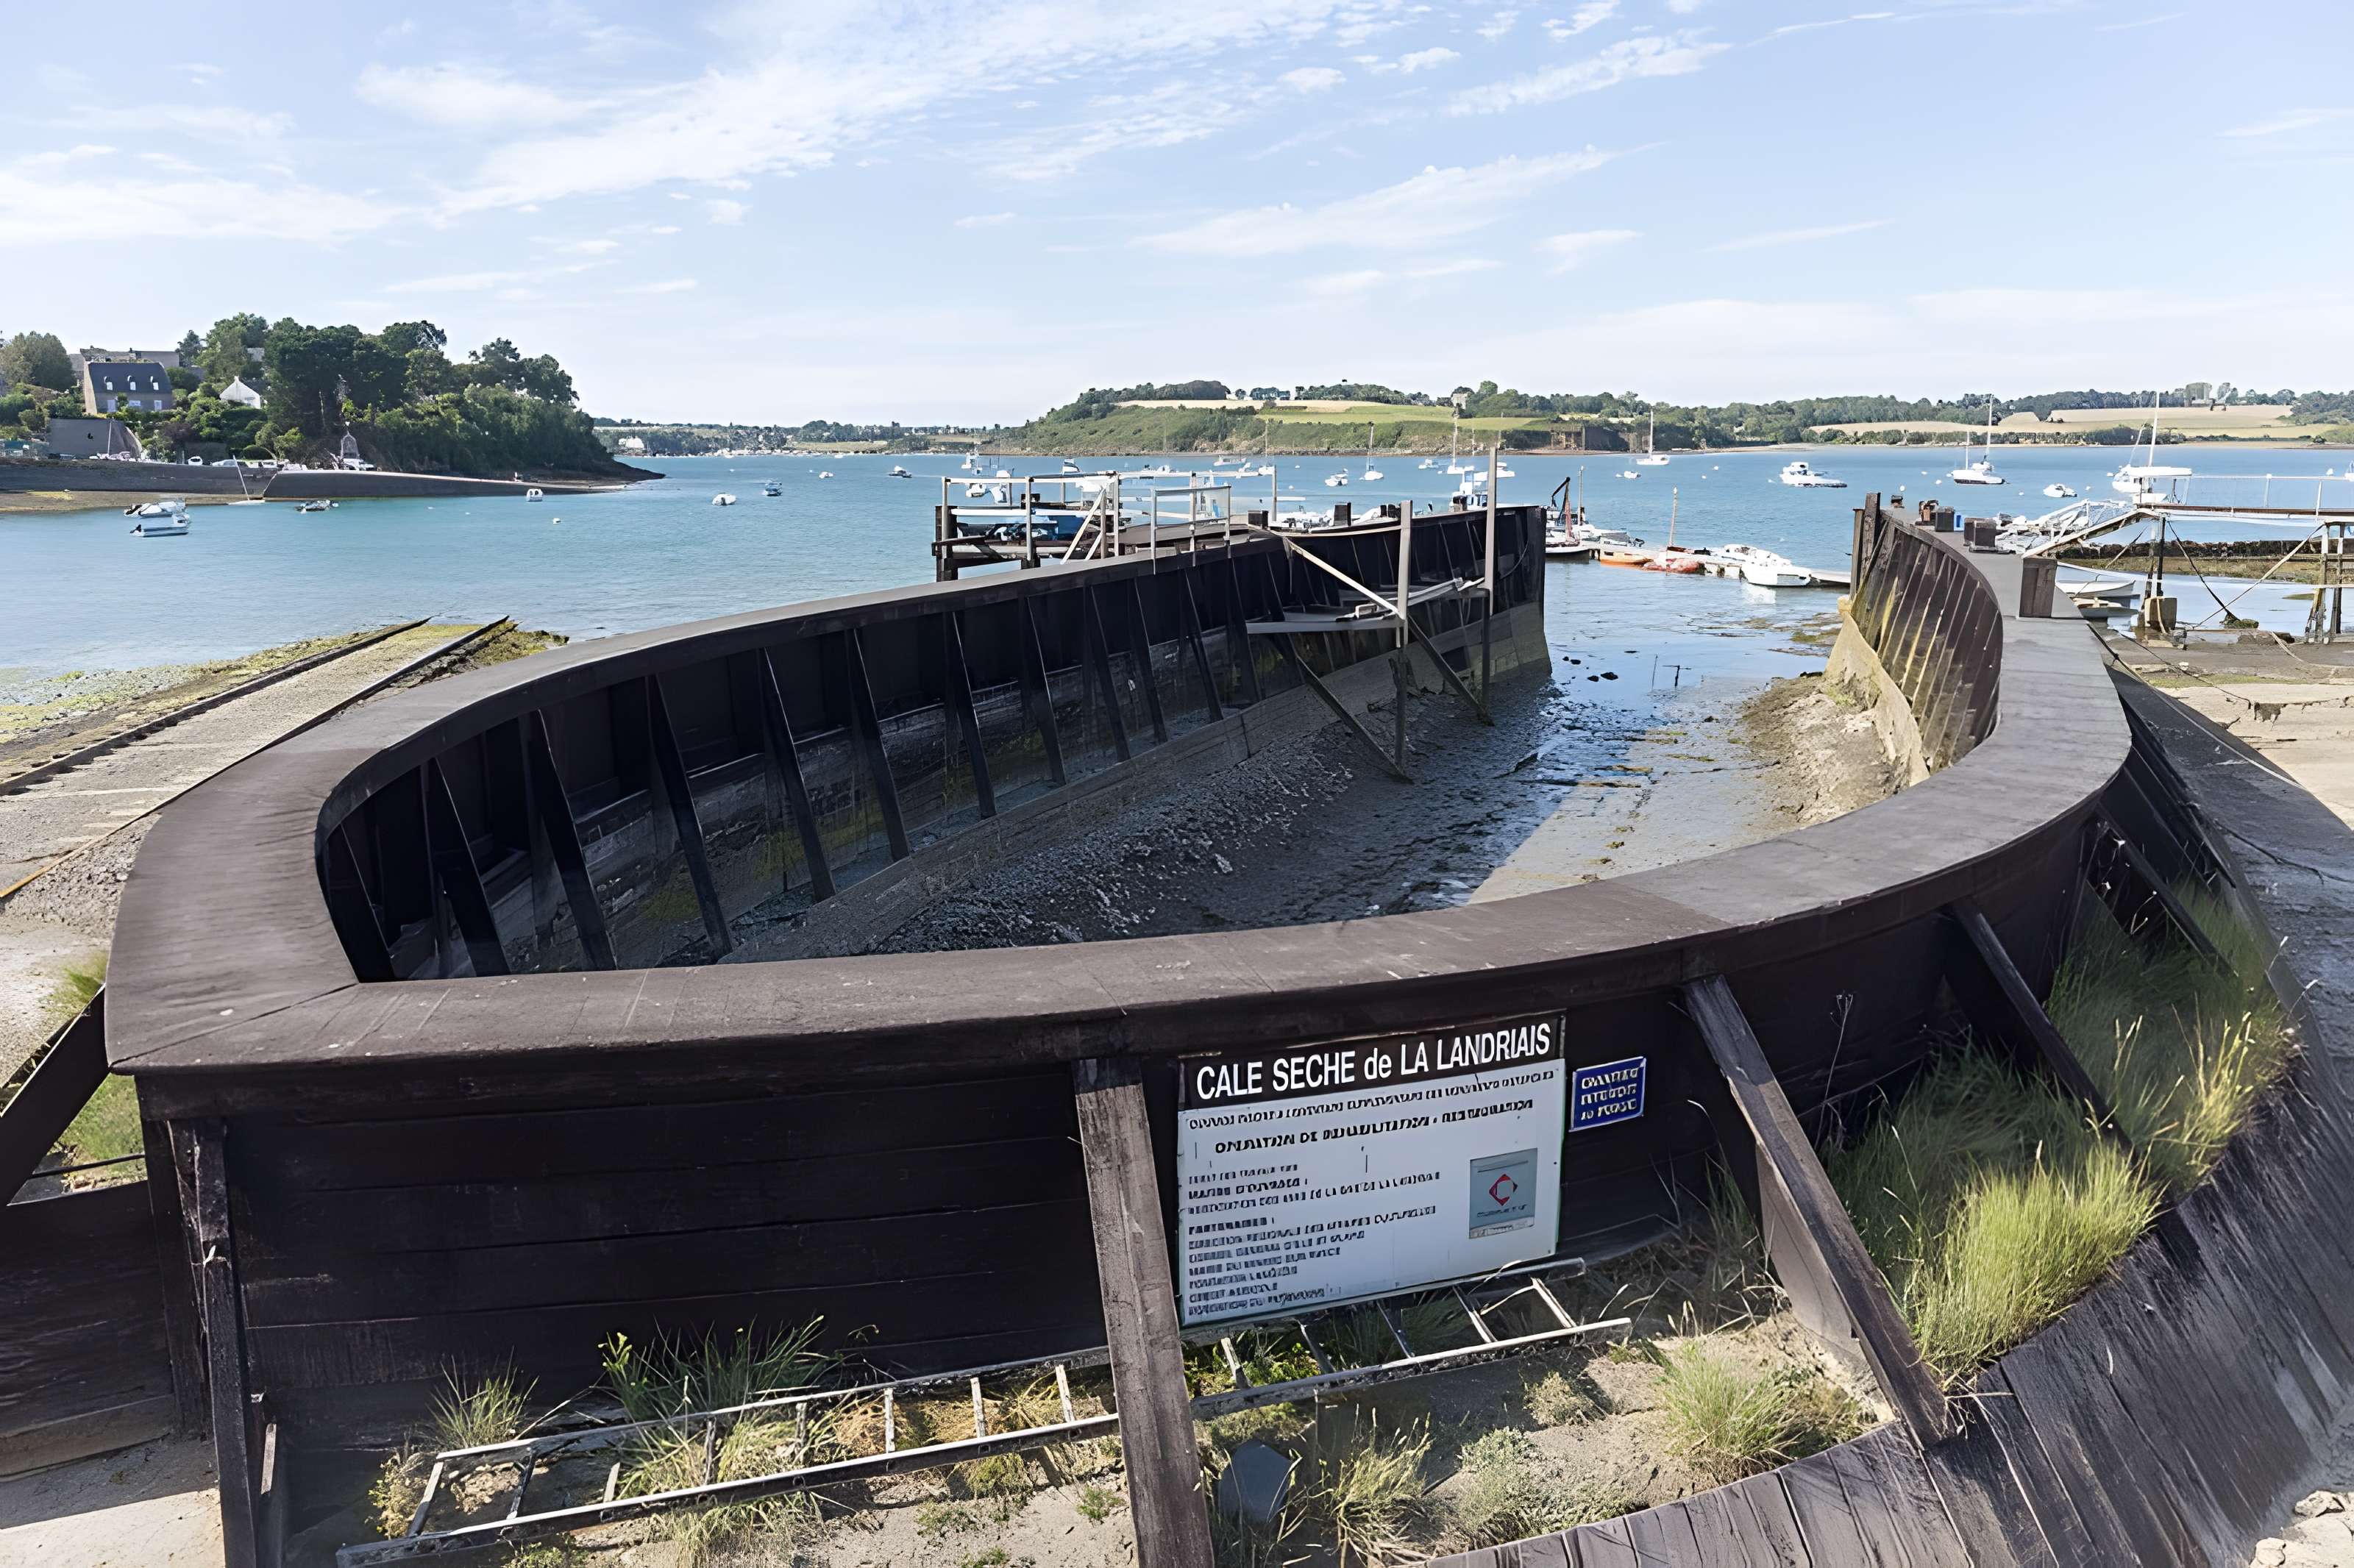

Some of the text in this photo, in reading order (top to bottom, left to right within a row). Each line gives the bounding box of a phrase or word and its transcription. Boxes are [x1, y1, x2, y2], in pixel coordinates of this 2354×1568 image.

[1197, 1023, 1551, 1100] CALE SECHE de LA LANDRIAIS
